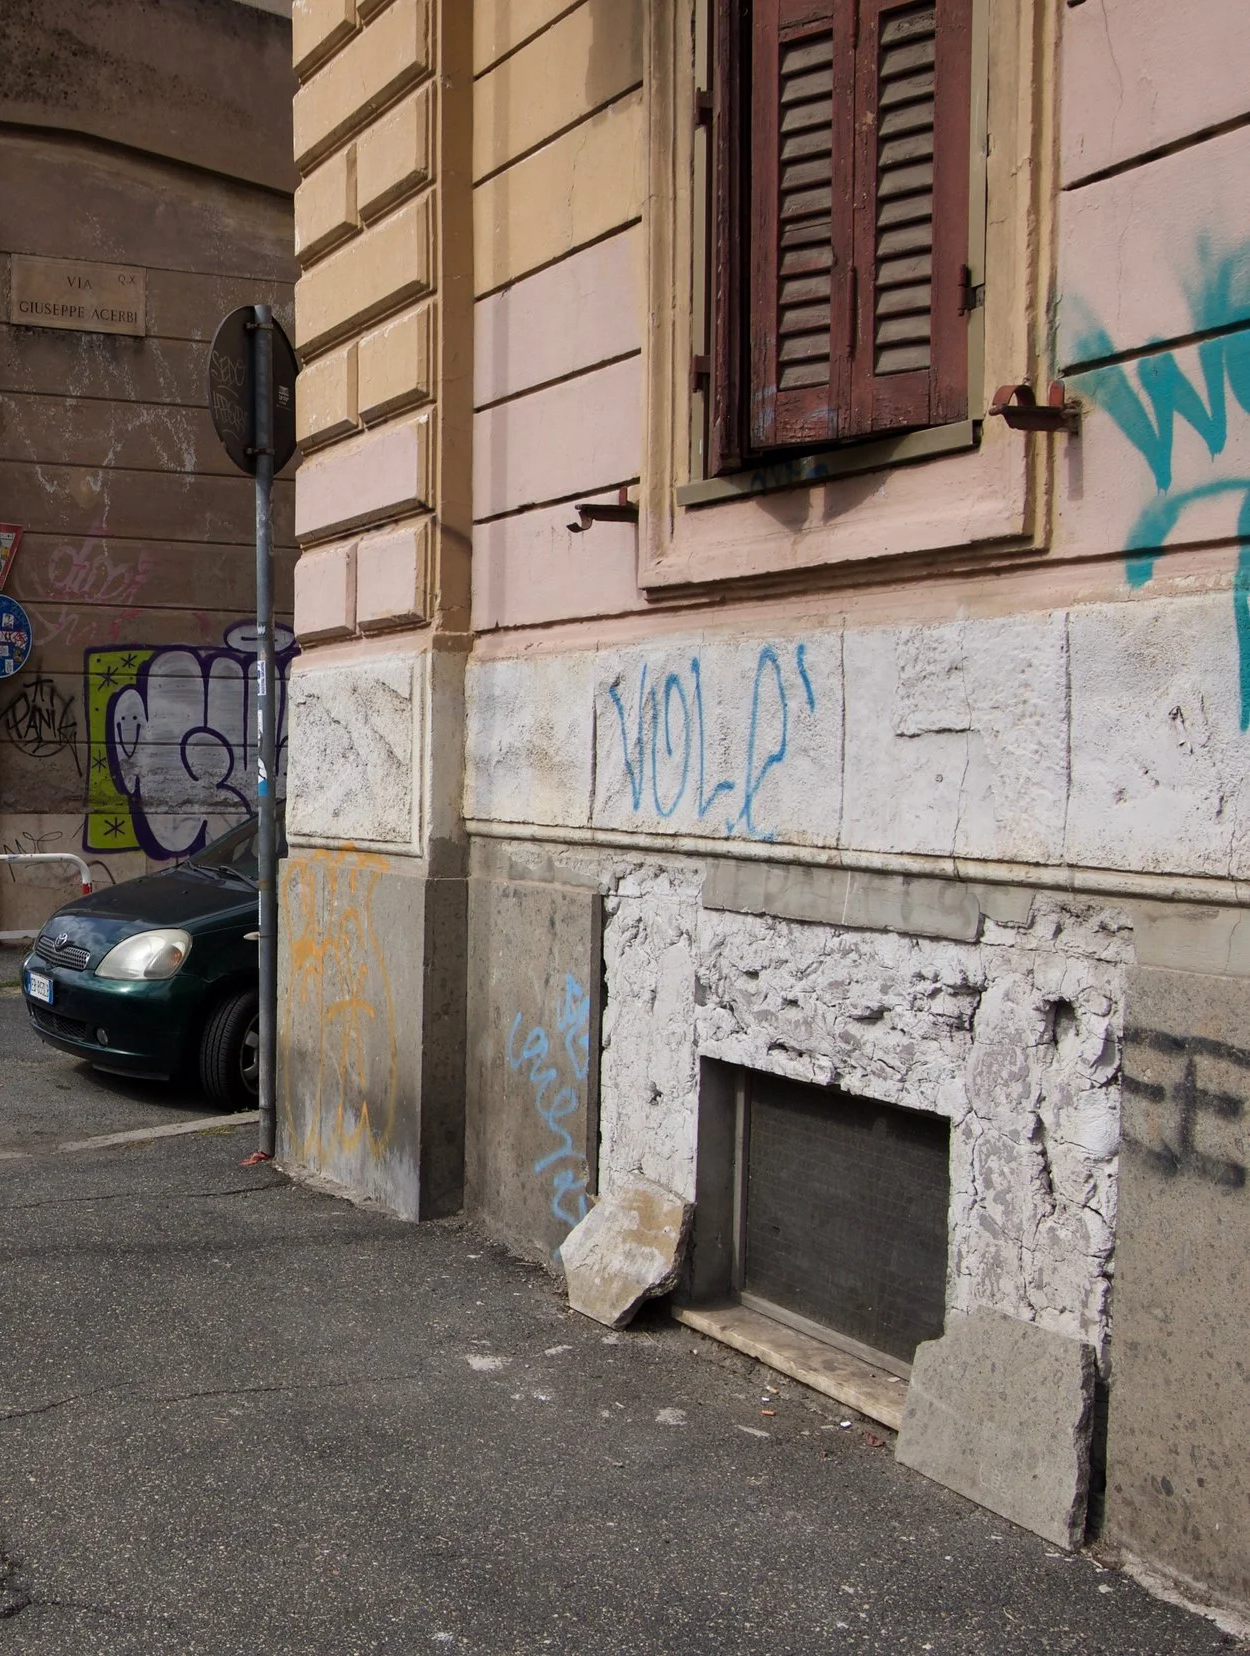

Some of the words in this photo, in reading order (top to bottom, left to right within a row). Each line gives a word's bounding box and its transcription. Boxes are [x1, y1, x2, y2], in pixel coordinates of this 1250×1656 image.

[67, 276, 92, 290] VIA
[19, 301, 85, 319] GIUSEPPE
[91, 308, 138, 323] ACERBI
